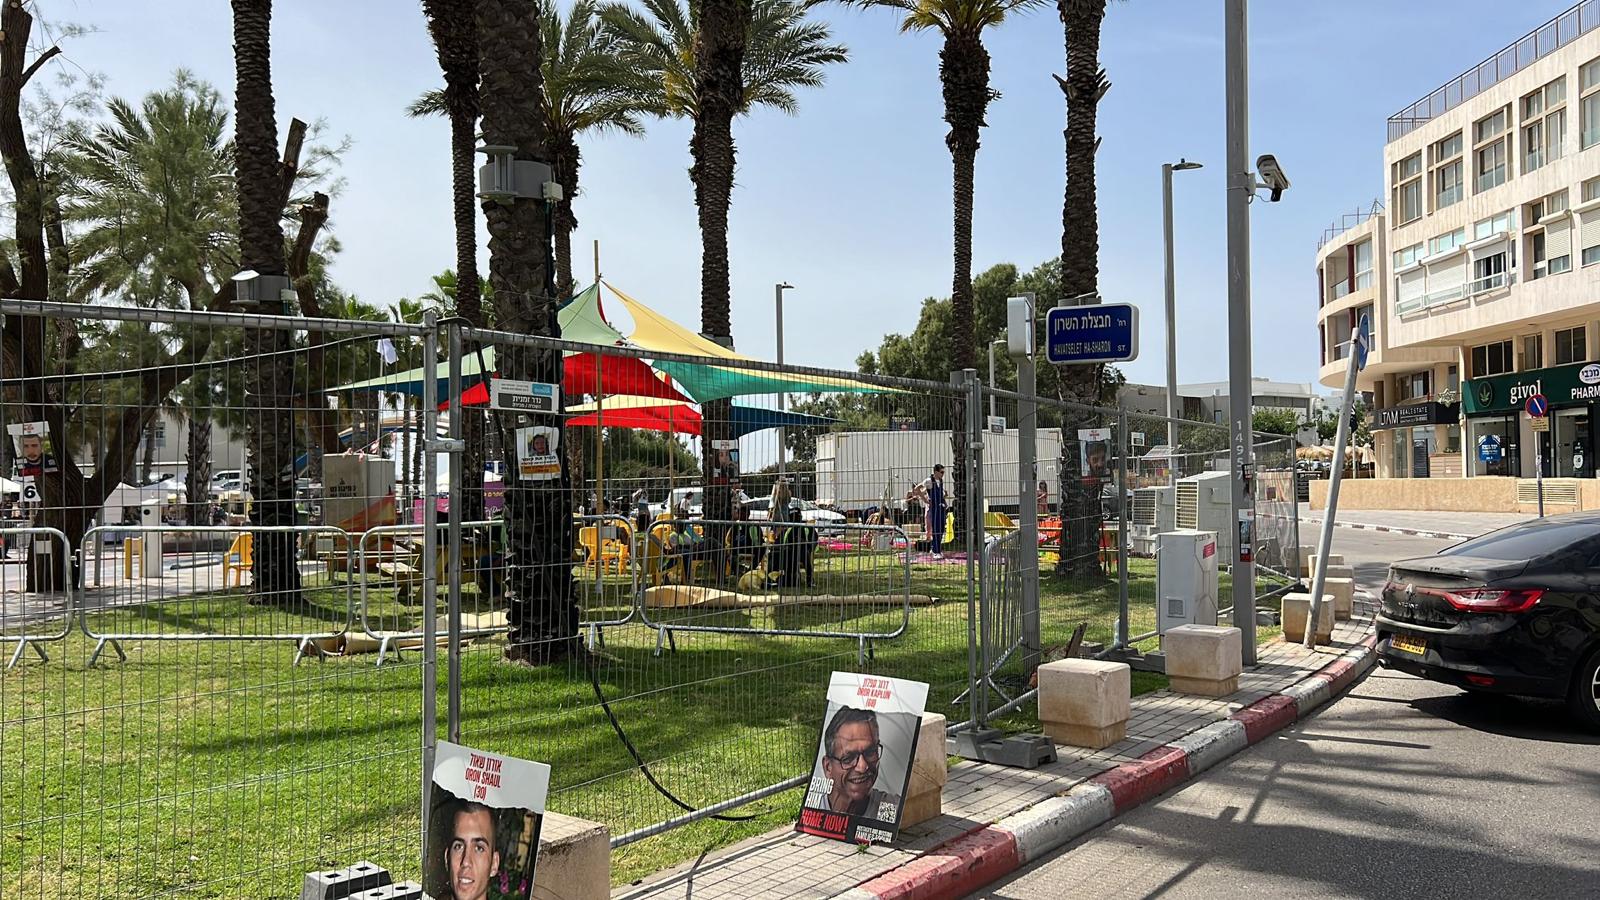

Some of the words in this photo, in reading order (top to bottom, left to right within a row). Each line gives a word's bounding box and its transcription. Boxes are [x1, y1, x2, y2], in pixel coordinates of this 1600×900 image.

[1054, 316, 1079, 336] השרון
[1081, 311, 1111, 329] חבצלת
[1581, 368, 1600, 378] מכבי
[1510, 379, 1542, 405] givol
[1380, 410, 1399, 426] JAM
[24, 485, 36, 499] 6
[465, 767, 481, 783] ORON
[481, 771, 501, 788] SHAUL
[809, 776, 834, 794] BRING
[473, 784, 487, 801] (30)
[804, 792, 823, 810] HIM
[800, 809, 824, 829] HOME
[823, 813, 849, 834] NOW!
